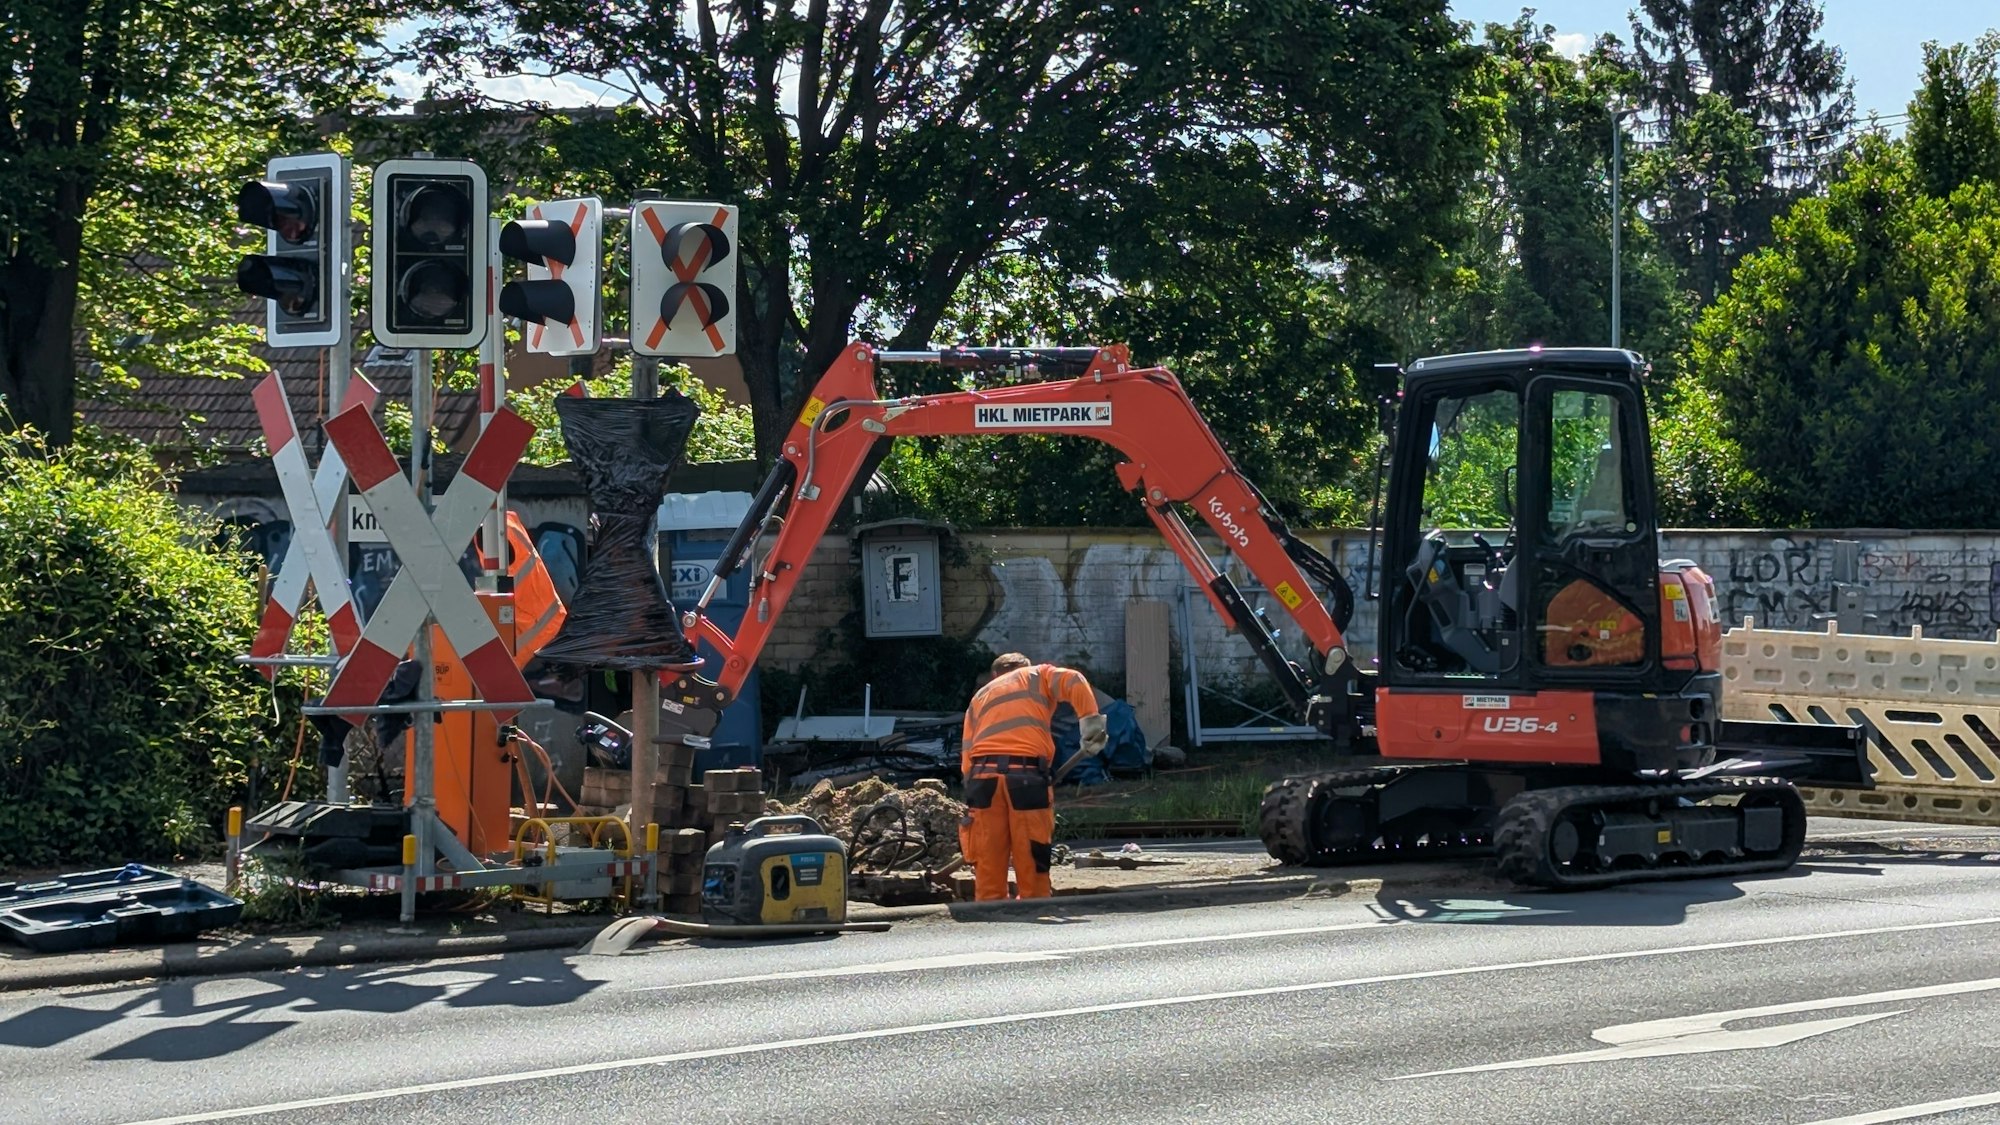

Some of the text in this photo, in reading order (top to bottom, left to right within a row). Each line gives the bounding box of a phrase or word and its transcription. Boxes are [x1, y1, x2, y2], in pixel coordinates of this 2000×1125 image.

[978, 407, 1091, 422] HKL MIETPARK
[1208, 496, 1249, 547] Kubota
[893, 557, 911, 599] F
[1483, 716, 1558, 733] U36-4
